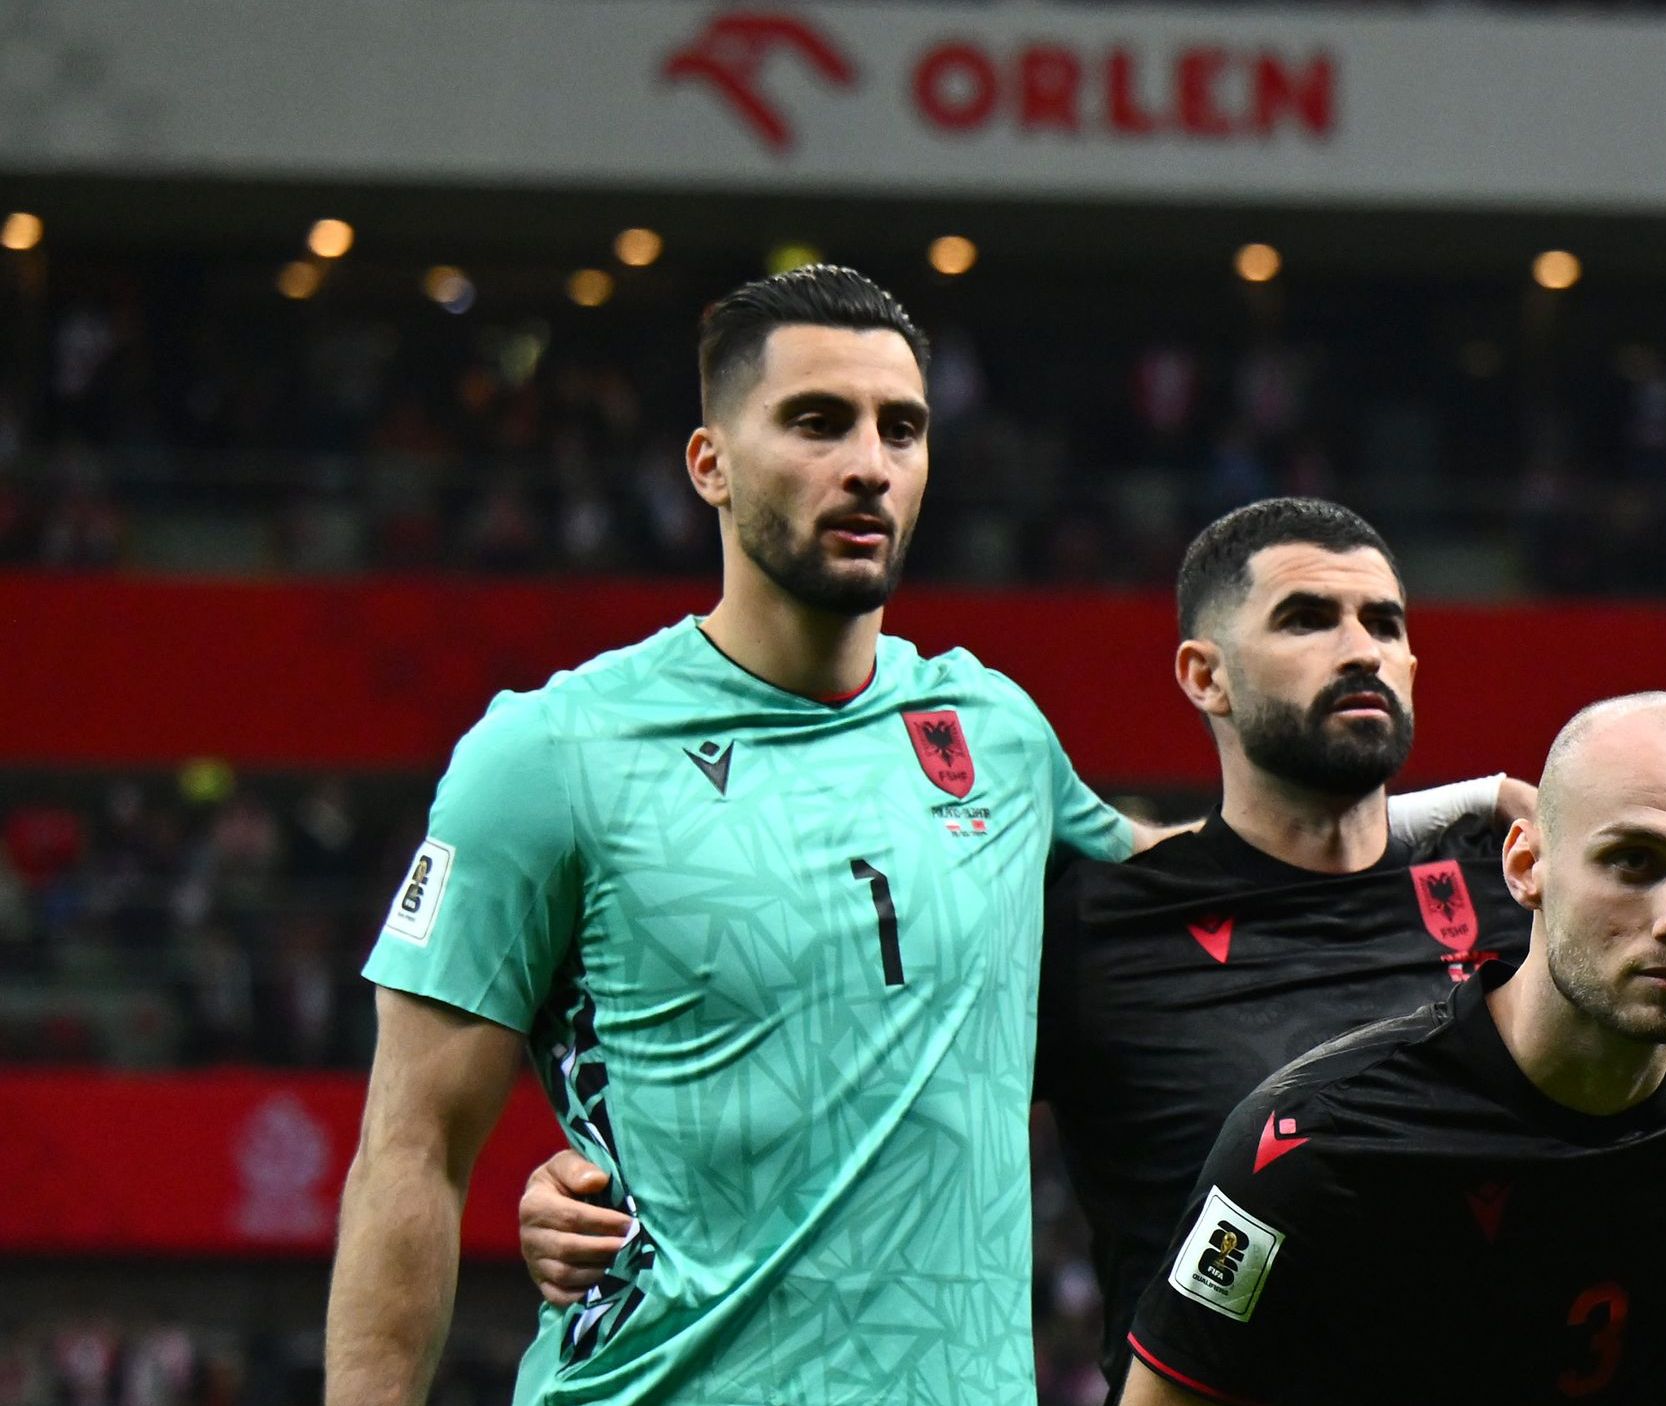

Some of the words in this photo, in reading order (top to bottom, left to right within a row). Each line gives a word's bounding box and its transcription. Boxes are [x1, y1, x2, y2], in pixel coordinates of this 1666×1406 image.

[914, 41, 1334, 136] ORLEN
[850, 859, 905, 986] 1
[1207, 1265, 1224, 1281] FIFA
[1553, 1281, 1630, 1397] 3
